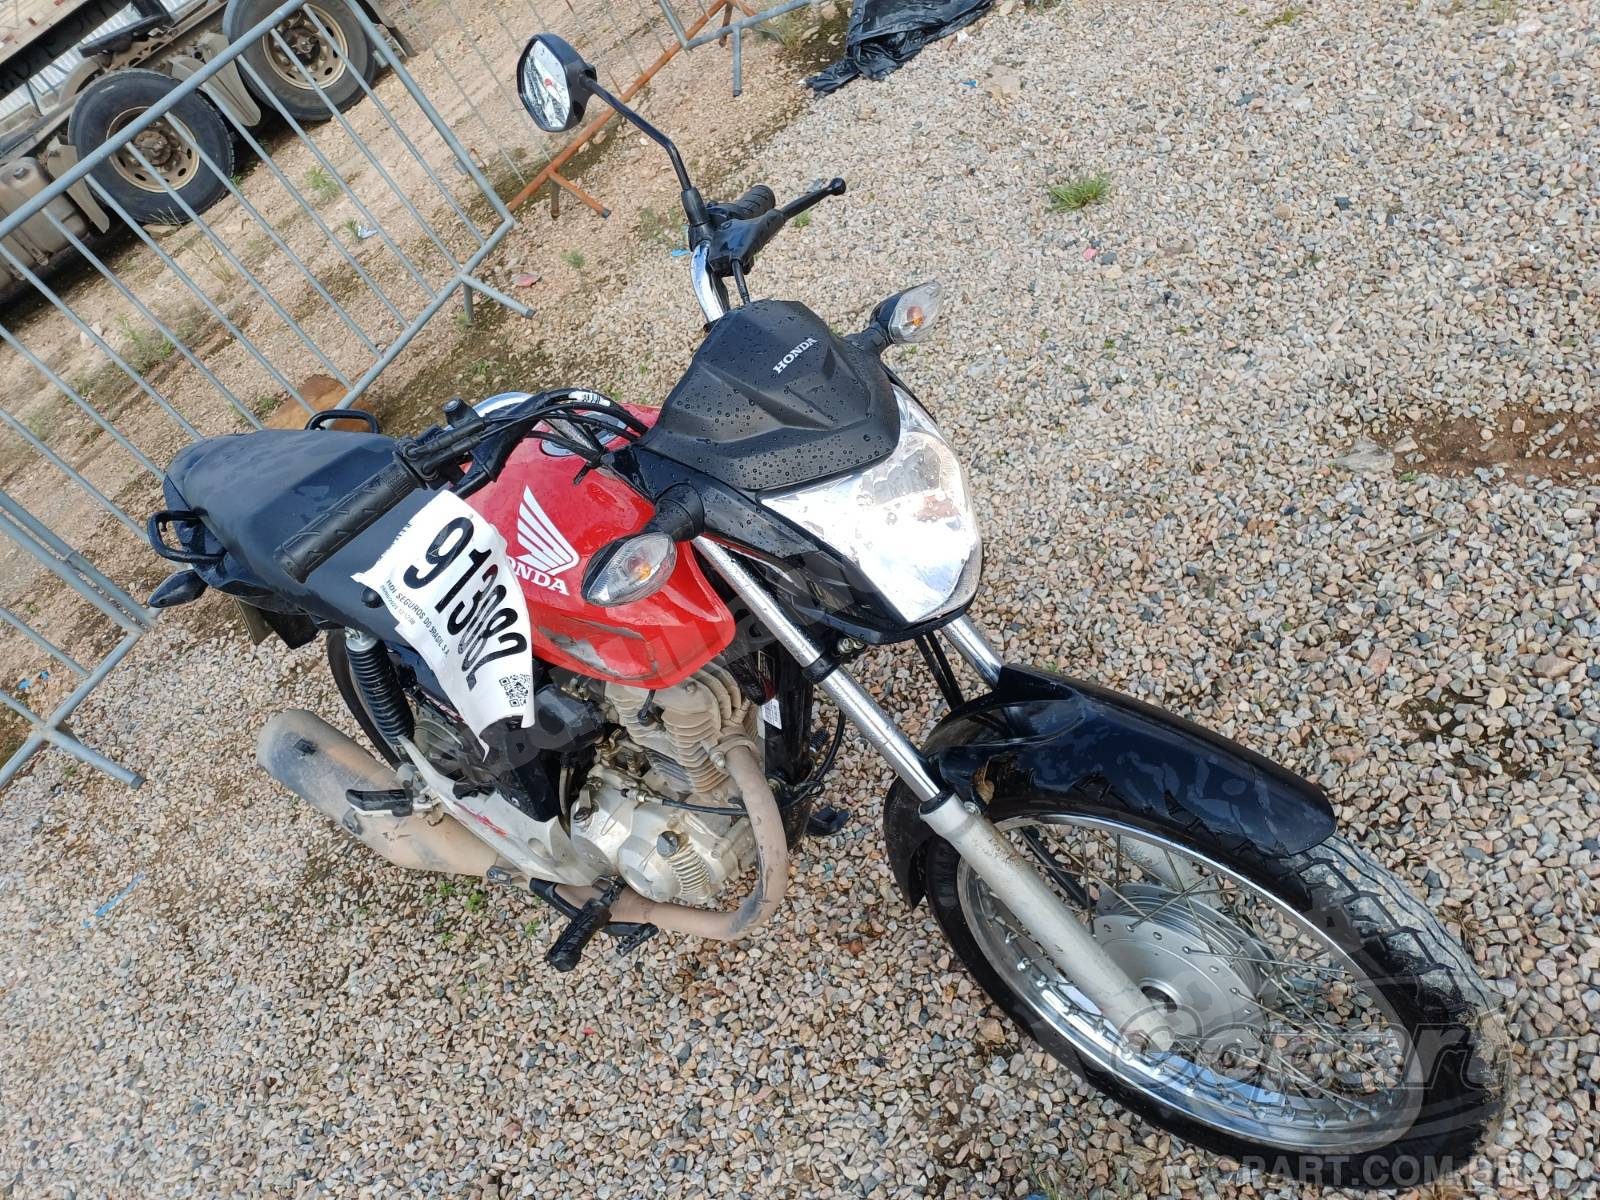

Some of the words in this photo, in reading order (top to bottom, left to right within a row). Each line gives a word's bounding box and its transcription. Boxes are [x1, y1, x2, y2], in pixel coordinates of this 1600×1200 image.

[773, 338, 818, 374] HONDA
[396, 592, 426, 620] SEGUROS
[423, 617, 433, 628] DO
[403, 517, 527, 692] 913082
